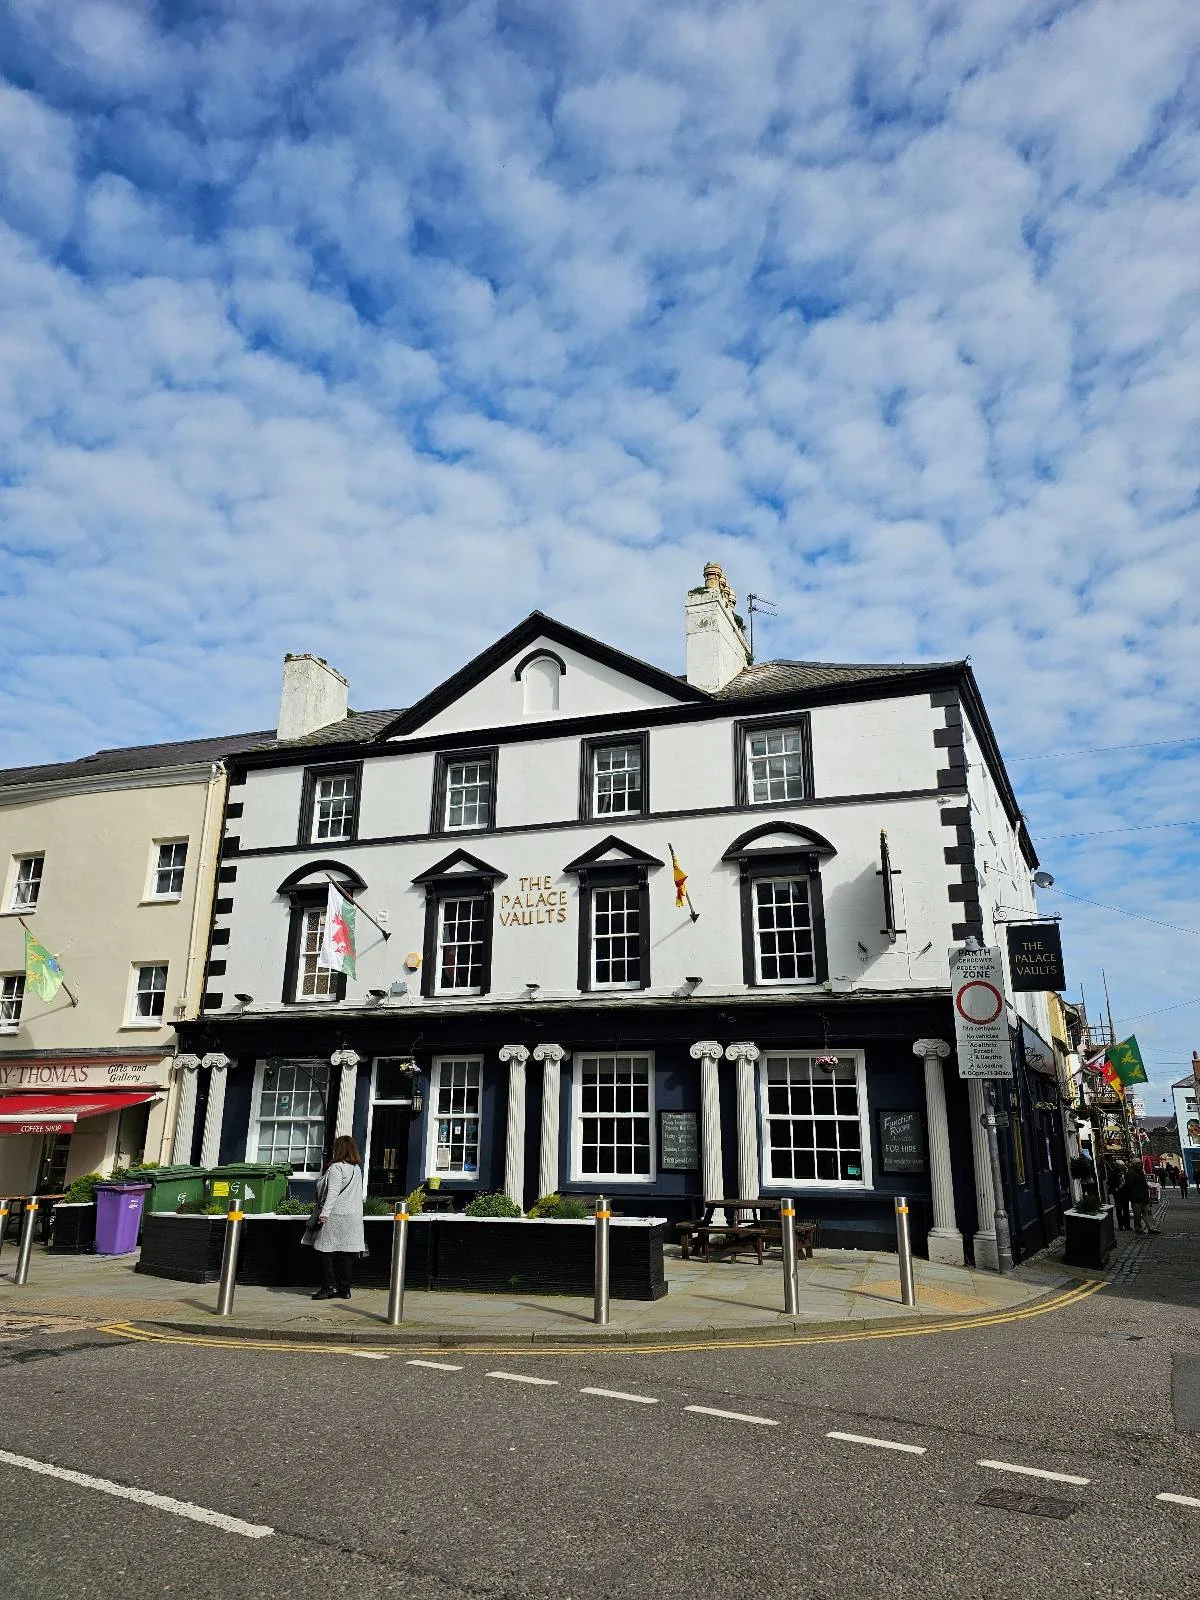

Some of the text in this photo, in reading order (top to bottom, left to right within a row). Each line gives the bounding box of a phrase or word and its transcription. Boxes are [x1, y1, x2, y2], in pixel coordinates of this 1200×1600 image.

[519, 875, 552, 892] THE
[501, 890, 567, 909] PALACE
[499, 907, 567, 926] VAULTS
[1021, 941, 1044, 951] THE
[1014, 953, 1057, 963] PALACE
[962, 970, 991, 979] ZONE
[1016, 965, 1057, 976] VAULTS
[107, 1063, 128, 1075] Gifts
[131, 1064, 147, 1072] and
[109, 1073, 141, 1083] Gallery
[20, 1124, 62, 1133] COFFEE SHOP
[901, 1145, 917, 1153] HIRE
